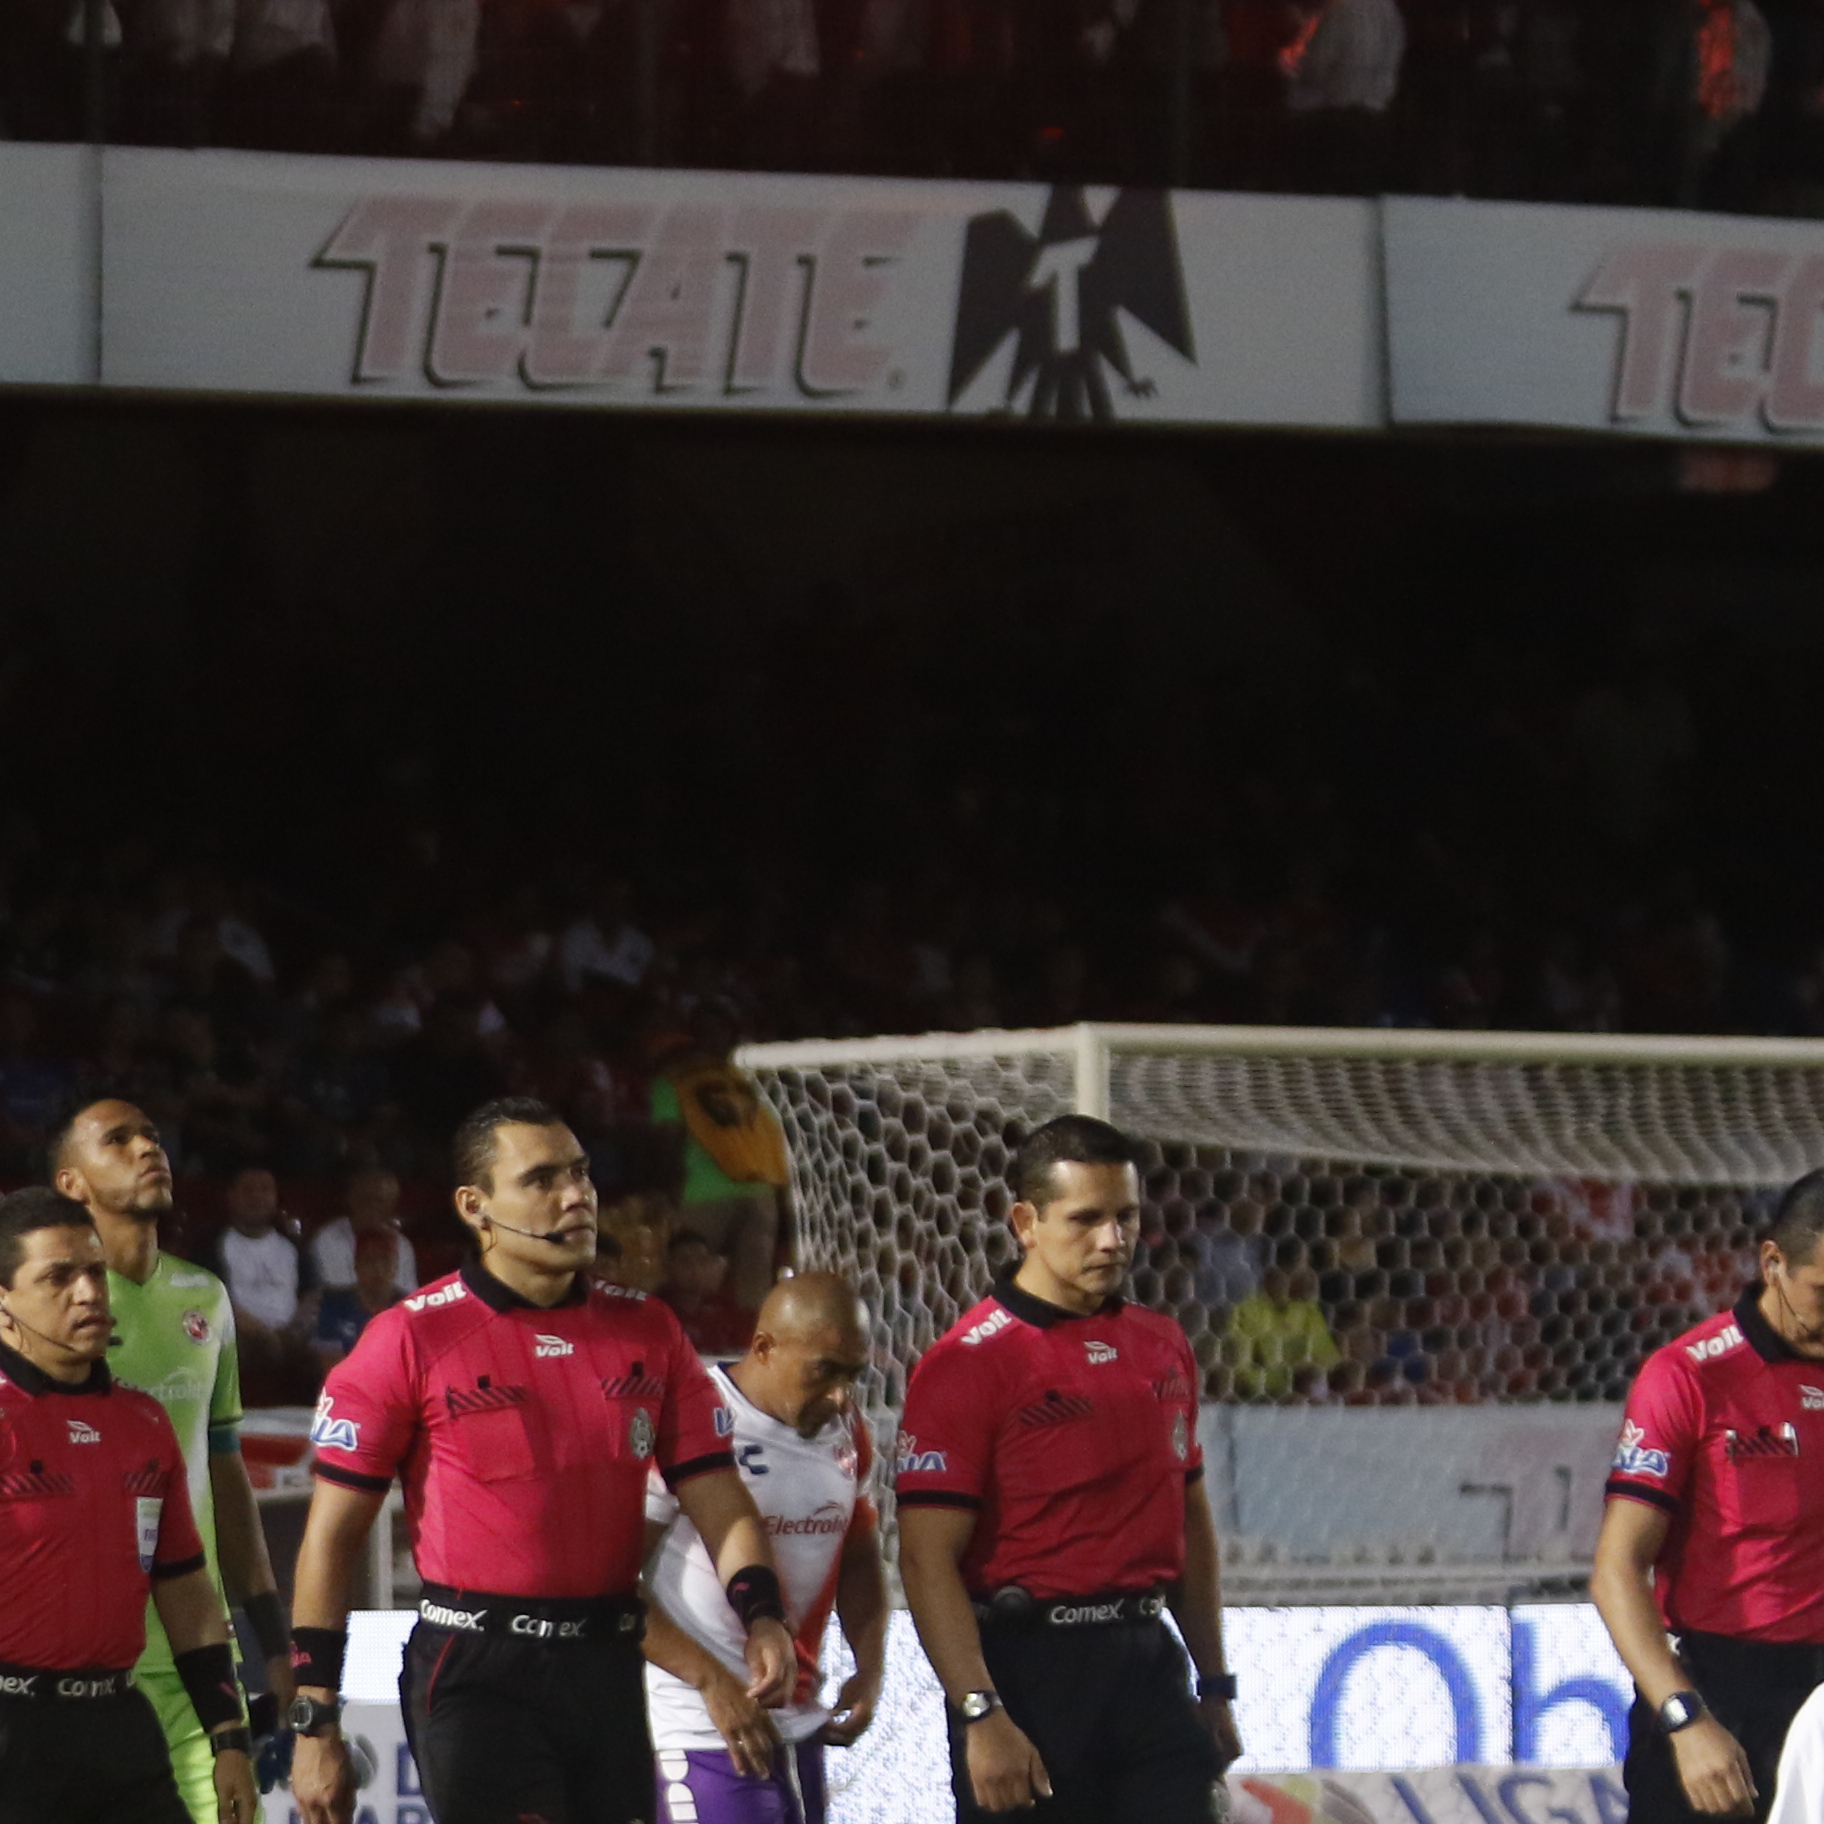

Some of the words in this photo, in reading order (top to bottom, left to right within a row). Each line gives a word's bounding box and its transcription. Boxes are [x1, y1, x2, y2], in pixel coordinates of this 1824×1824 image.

[309, 192, 920, 398] TECATE
[404, 1282, 467, 1312] Voit
[960, 1308, 1012, 1348] Voit
[535, 1343, 574, 1358] Voit
[1088, 1348, 1118, 1365] Voit
[1686, 1324, 1746, 1364] Voit
[69, 1430, 102, 1445] Voit
[1050, 1599, 1122, 1625] Comex
